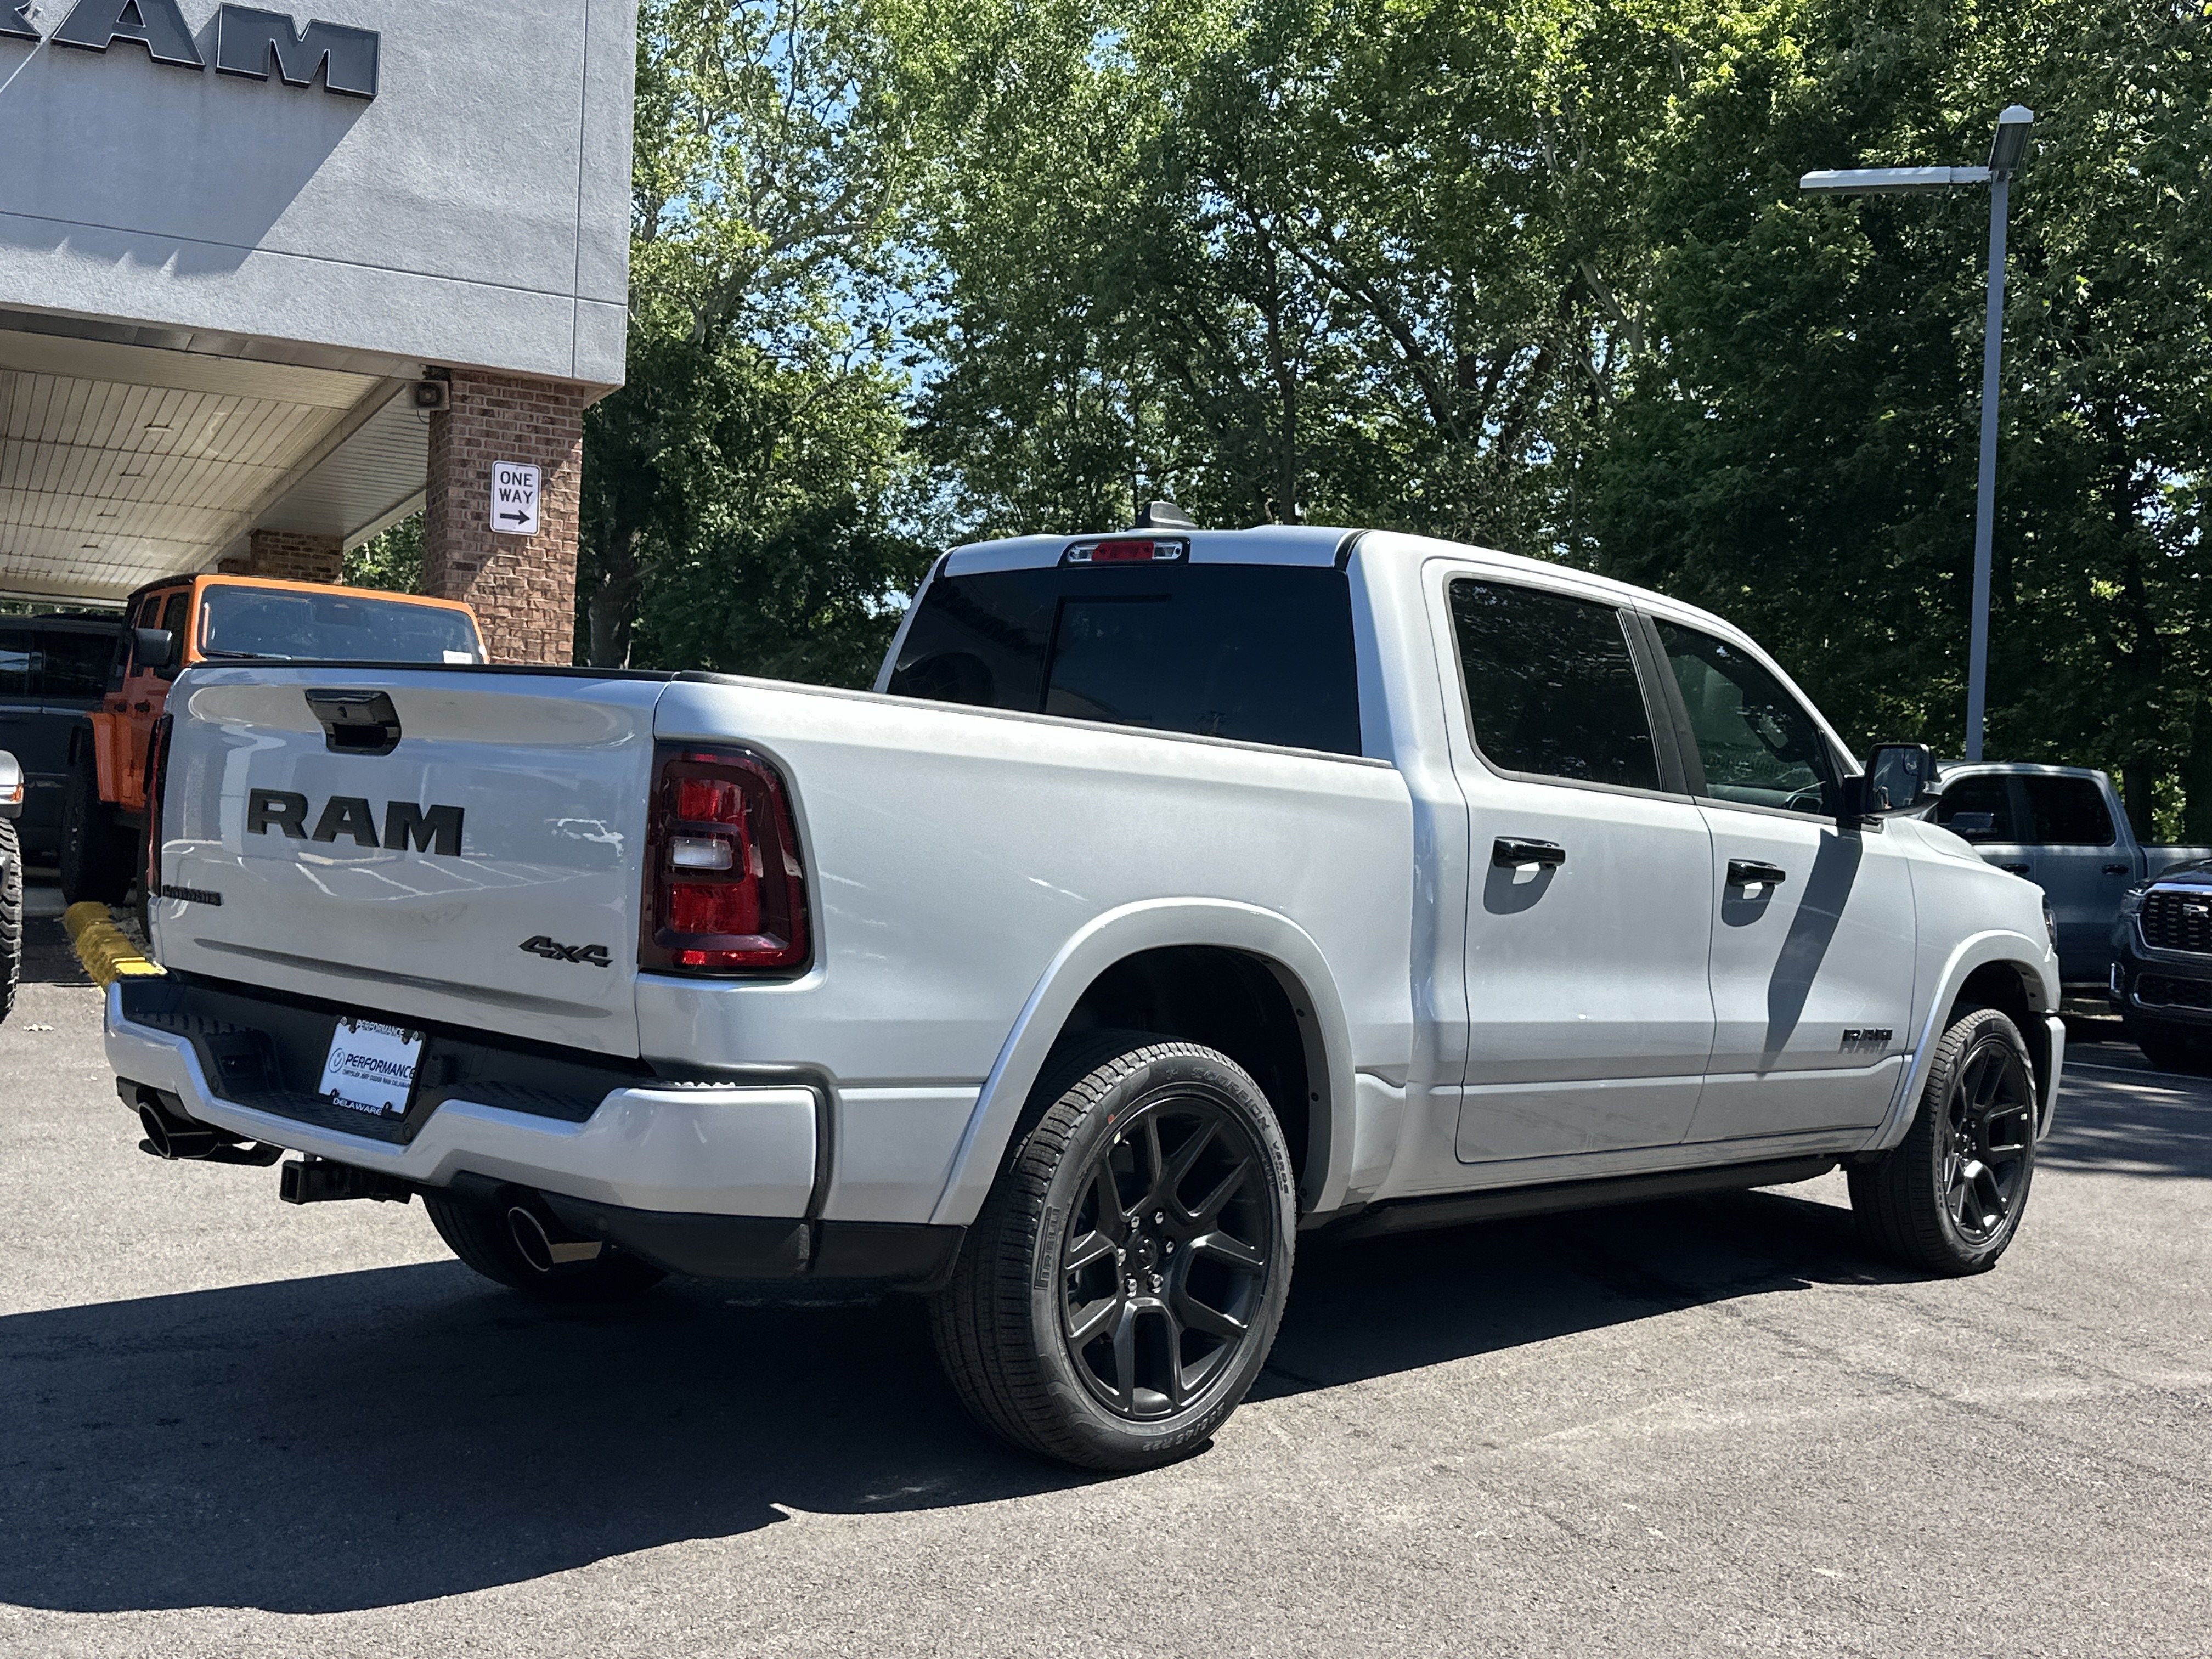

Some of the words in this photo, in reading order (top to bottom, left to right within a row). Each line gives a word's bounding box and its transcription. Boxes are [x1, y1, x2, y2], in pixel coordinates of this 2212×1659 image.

[500, 470, 533, 488] ONE
[499, 488, 533, 504] WAY
[247, 788, 465, 857] RAM
[345, 1053, 415, 1079] PERFORMANCE
[391, 1079, 411, 1088] DELAWAR
[332, 1098, 382, 1116] DELAWARE
[1034, 1206, 1060, 1290] PIRELLI
